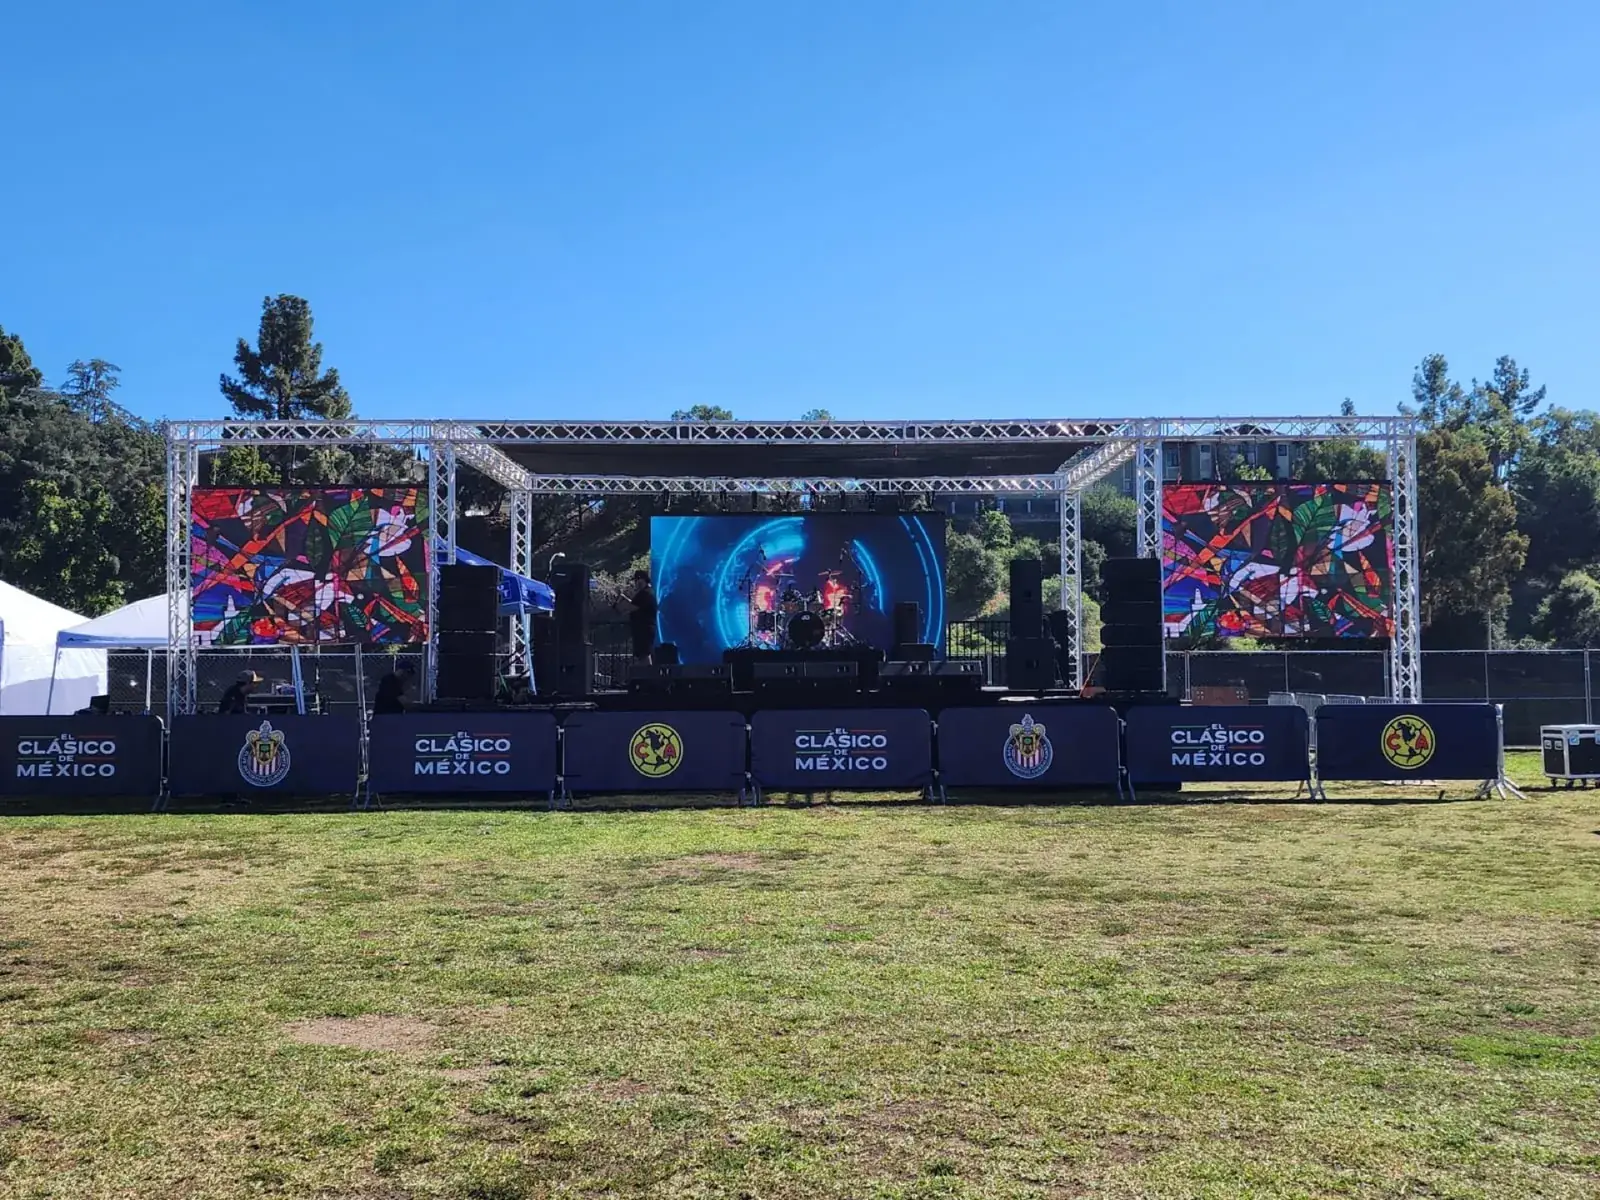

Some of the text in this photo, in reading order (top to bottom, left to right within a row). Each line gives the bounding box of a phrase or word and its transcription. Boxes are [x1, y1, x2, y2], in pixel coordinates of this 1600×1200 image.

[835, 727, 849, 735] EL
[1170, 727, 1265, 744] CLÁSICO
[18, 738, 116, 754] CLÁSICO
[415, 736, 511, 752] CLÁSICO
[795, 732, 887, 748] CLÁSICO
[795, 754, 887, 770] MÉXICO
[1171, 749, 1265, 766] MÉXICO
[17, 761, 115, 777] MÉXICO
[414, 758, 511, 775] MÉXICO
